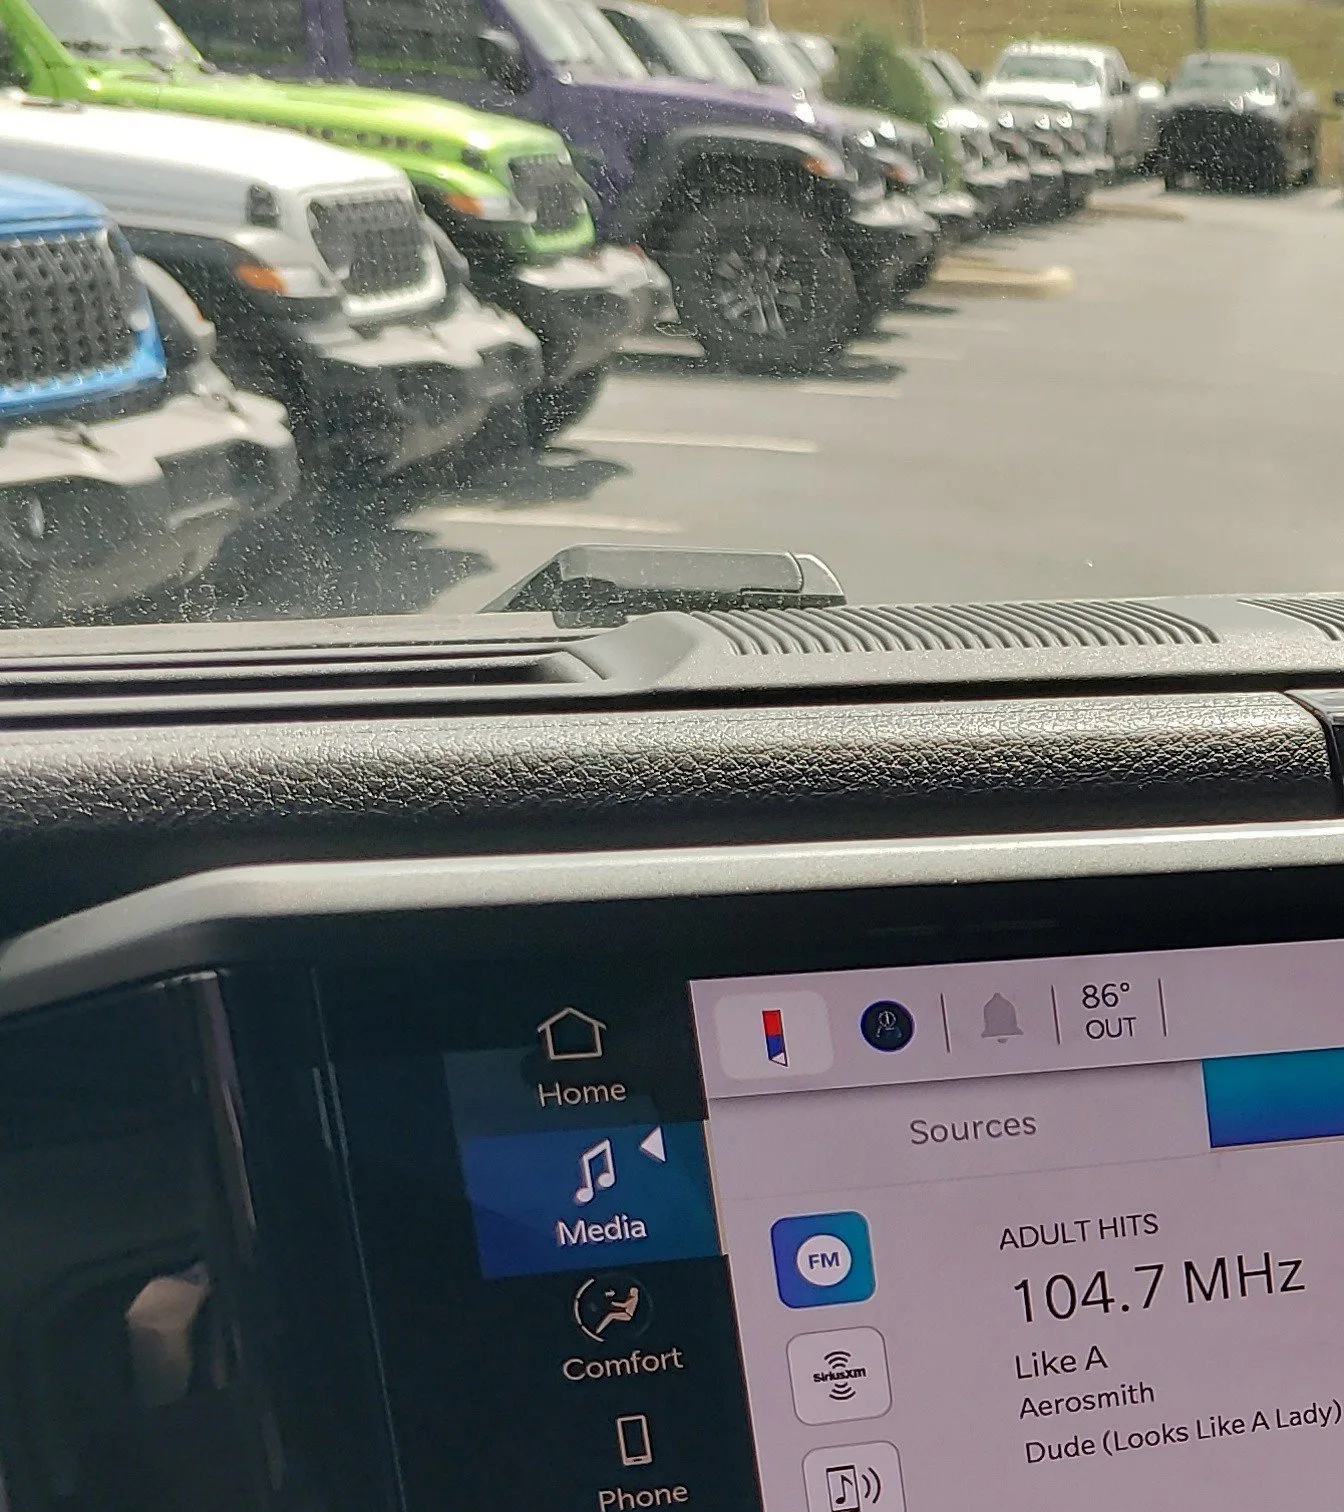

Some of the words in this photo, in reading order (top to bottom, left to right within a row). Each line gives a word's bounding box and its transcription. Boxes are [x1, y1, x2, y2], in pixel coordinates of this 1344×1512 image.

[1081, 982, 1132, 1011] 86°
[1085, 1014, 1138, 1041] OUT
[537, 1078, 627, 1109] Home
[909, 1111, 1038, 1145] Sources
[556, 1214, 648, 1248] Media
[999, 1218, 1091, 1252] ADULT
[1098, 1212, 1160, 1242] HITS
[808, 1249, 841, 1271] FM
[1014, 1263, 1165, 1324] 104.7
[1183, 1251, 1306, 1306] MHz
[562, 1346, 684, 1384] Comfort
[1015, 1349, 1078, 1381] Like
[1084, 1346, 1108, 1372] A
[1018, 1381, 1156, 1420] Aerosmith
[1025, 1435, 1097, 1464] Dude
[1102, 1419, 1190, 1457] (Looks
[1196, 1414, 1246, 1442] Like
[1250, 1413, 1270, 1434] A
[1275, 1397, 1343, 1432] Lady)
